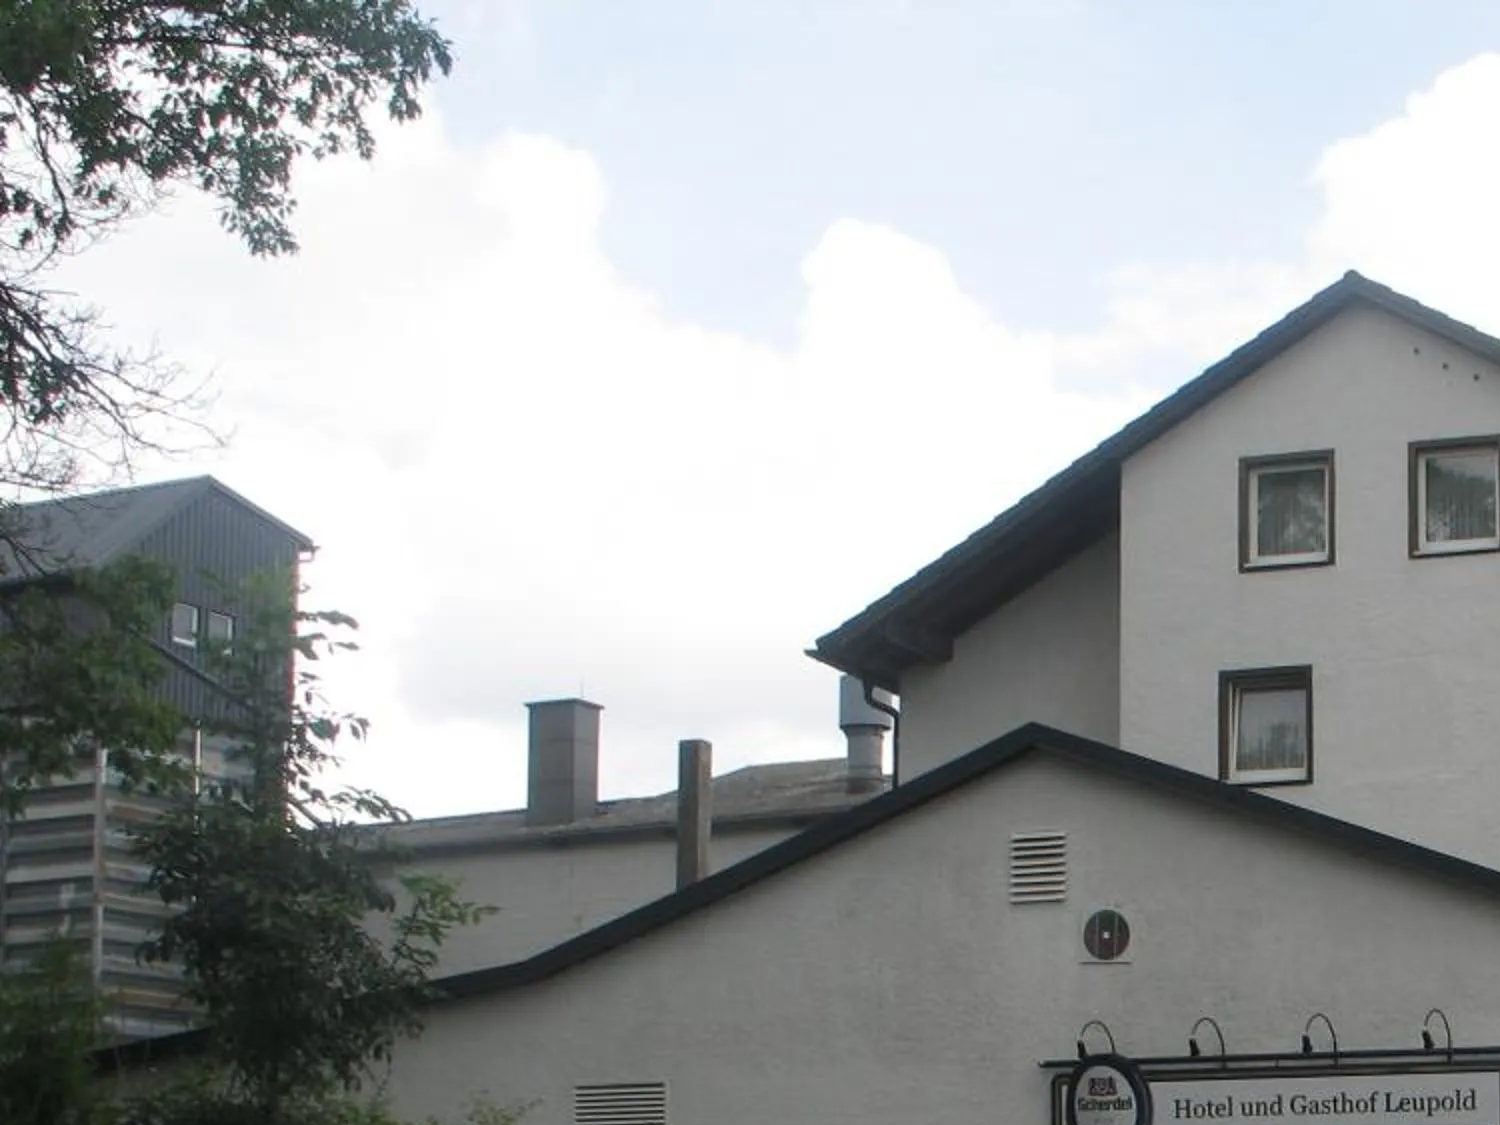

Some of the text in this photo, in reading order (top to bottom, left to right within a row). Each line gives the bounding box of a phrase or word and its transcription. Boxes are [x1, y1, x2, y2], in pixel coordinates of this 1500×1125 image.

[1174, 1088, 1477, 1119] Hotel und Gasthof Leupold
